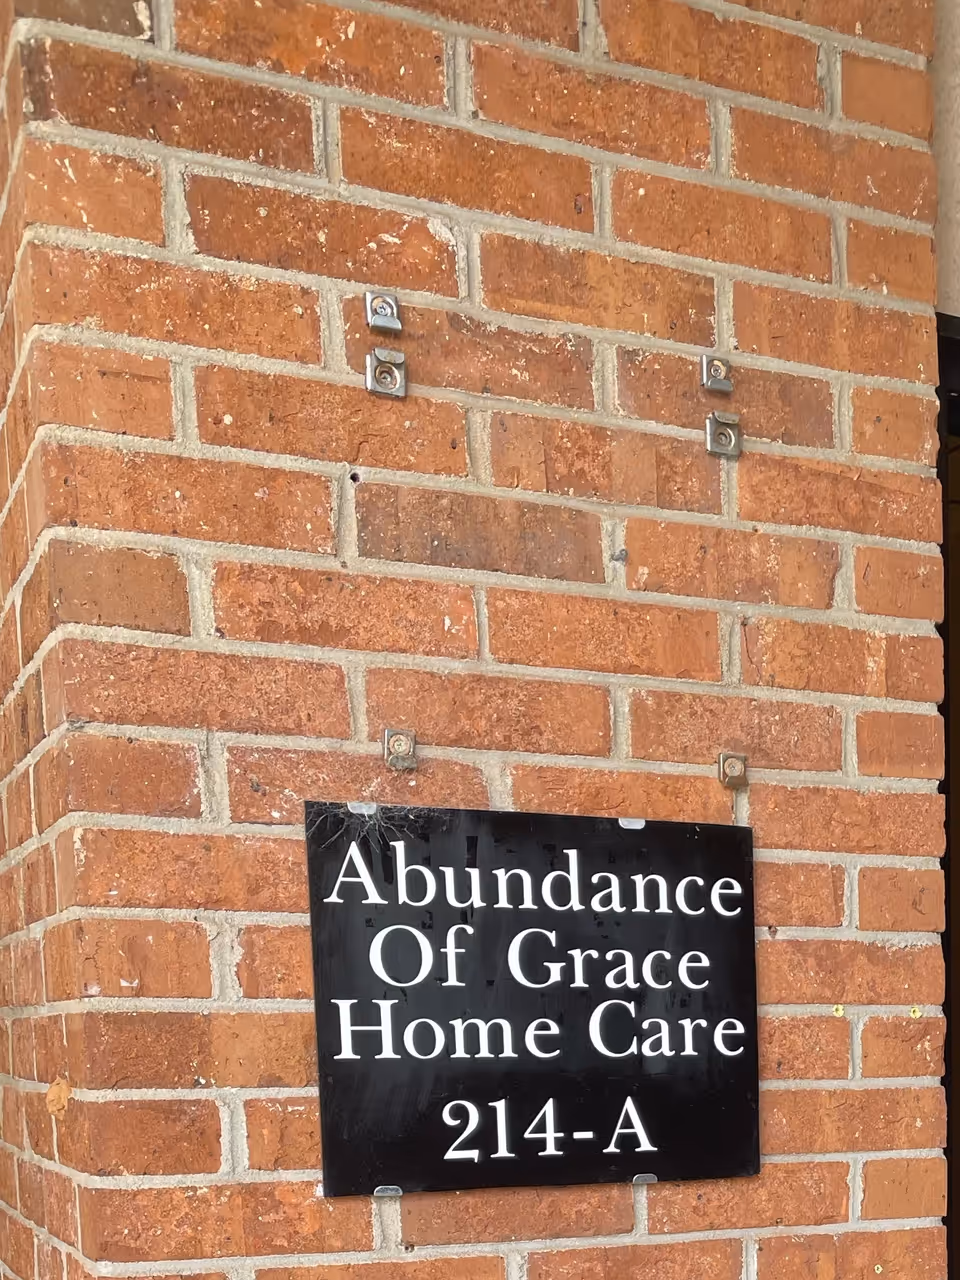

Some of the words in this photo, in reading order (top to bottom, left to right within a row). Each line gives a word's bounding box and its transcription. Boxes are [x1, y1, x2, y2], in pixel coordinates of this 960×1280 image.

[323, 840, 743, 917] Abundance
[369, 924, 474, 987] Of
[507, 928, 710, 990] Grace
[330, 999, 561, 1060] Home
[588, 999, 745, 1058] Care
[442, 1095, 658, 1162] 214-A
